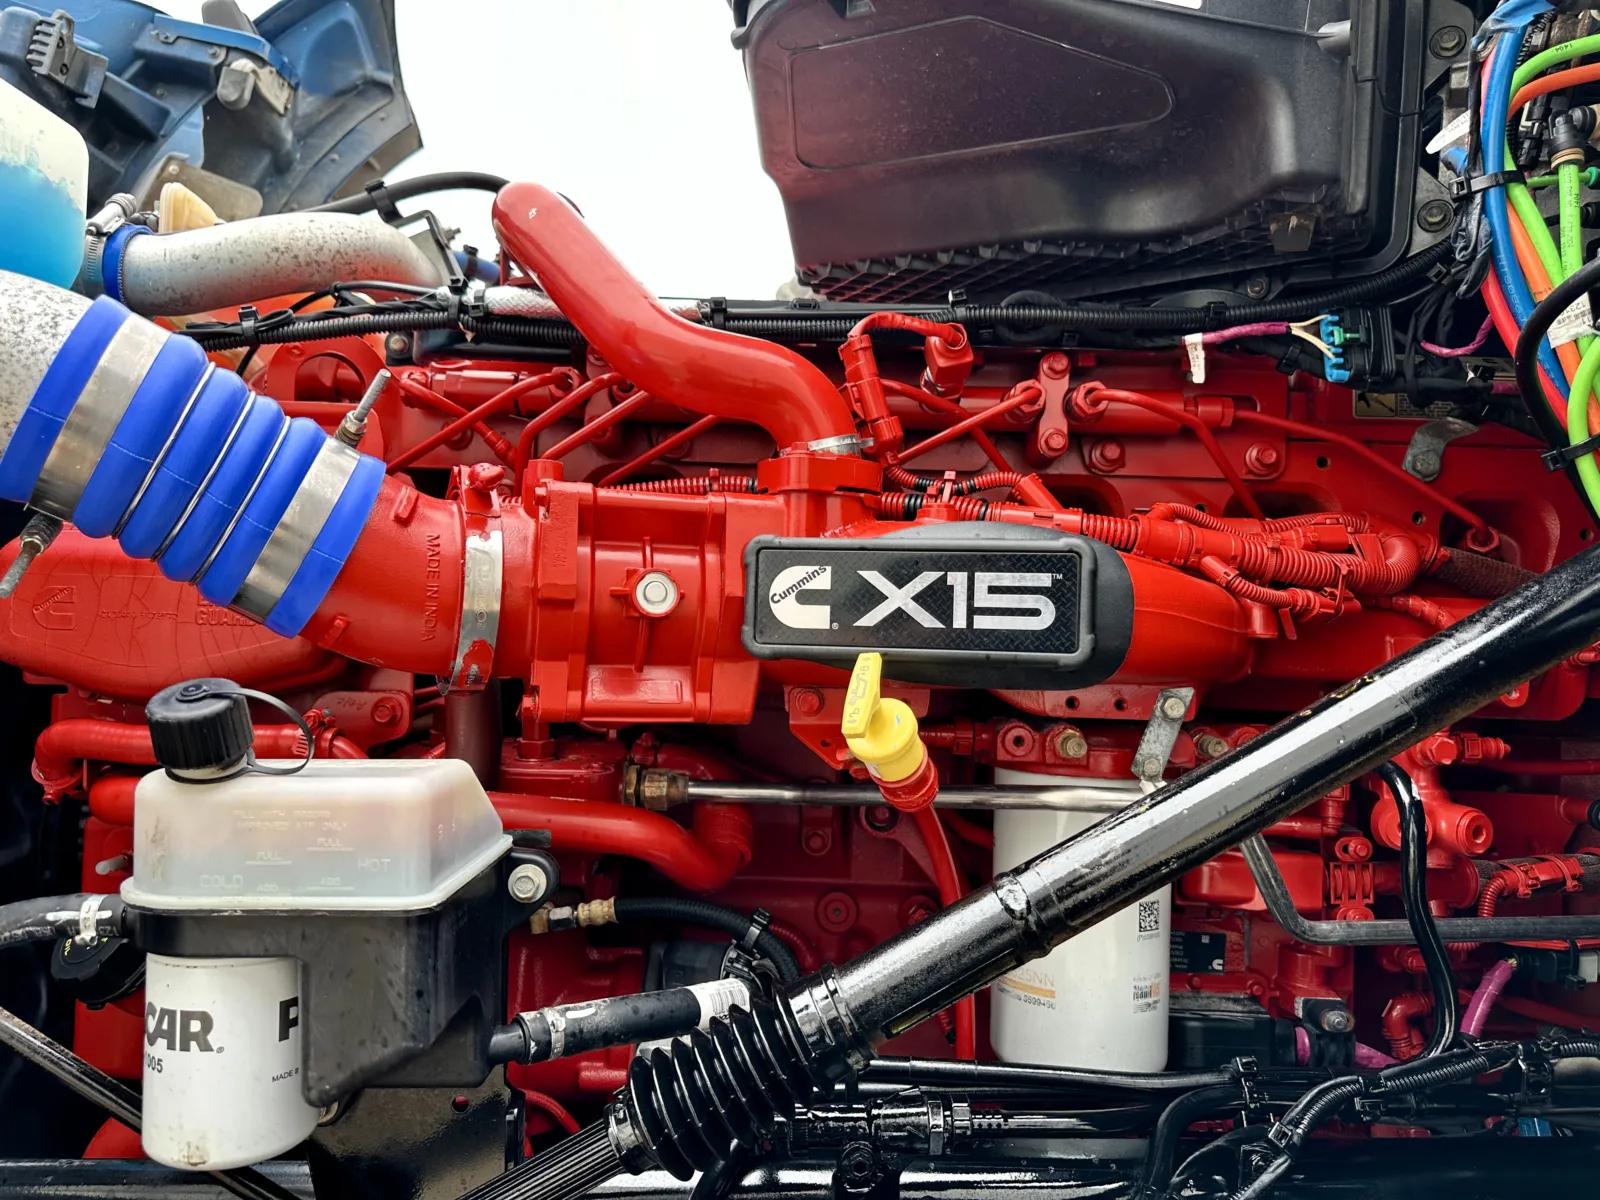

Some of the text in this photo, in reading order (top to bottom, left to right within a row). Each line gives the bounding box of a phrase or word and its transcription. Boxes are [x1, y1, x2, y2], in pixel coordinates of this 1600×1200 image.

[421, 534, 440, 642] MADE IN INDIA
[770, 565, 827, 604] Cummins
[852, 570, 1056, 630] X15
[357, 857, 391, 873] HOT
[199, 874, 244, 889] COLD
[272, 1070, 294, 1082] MADE
